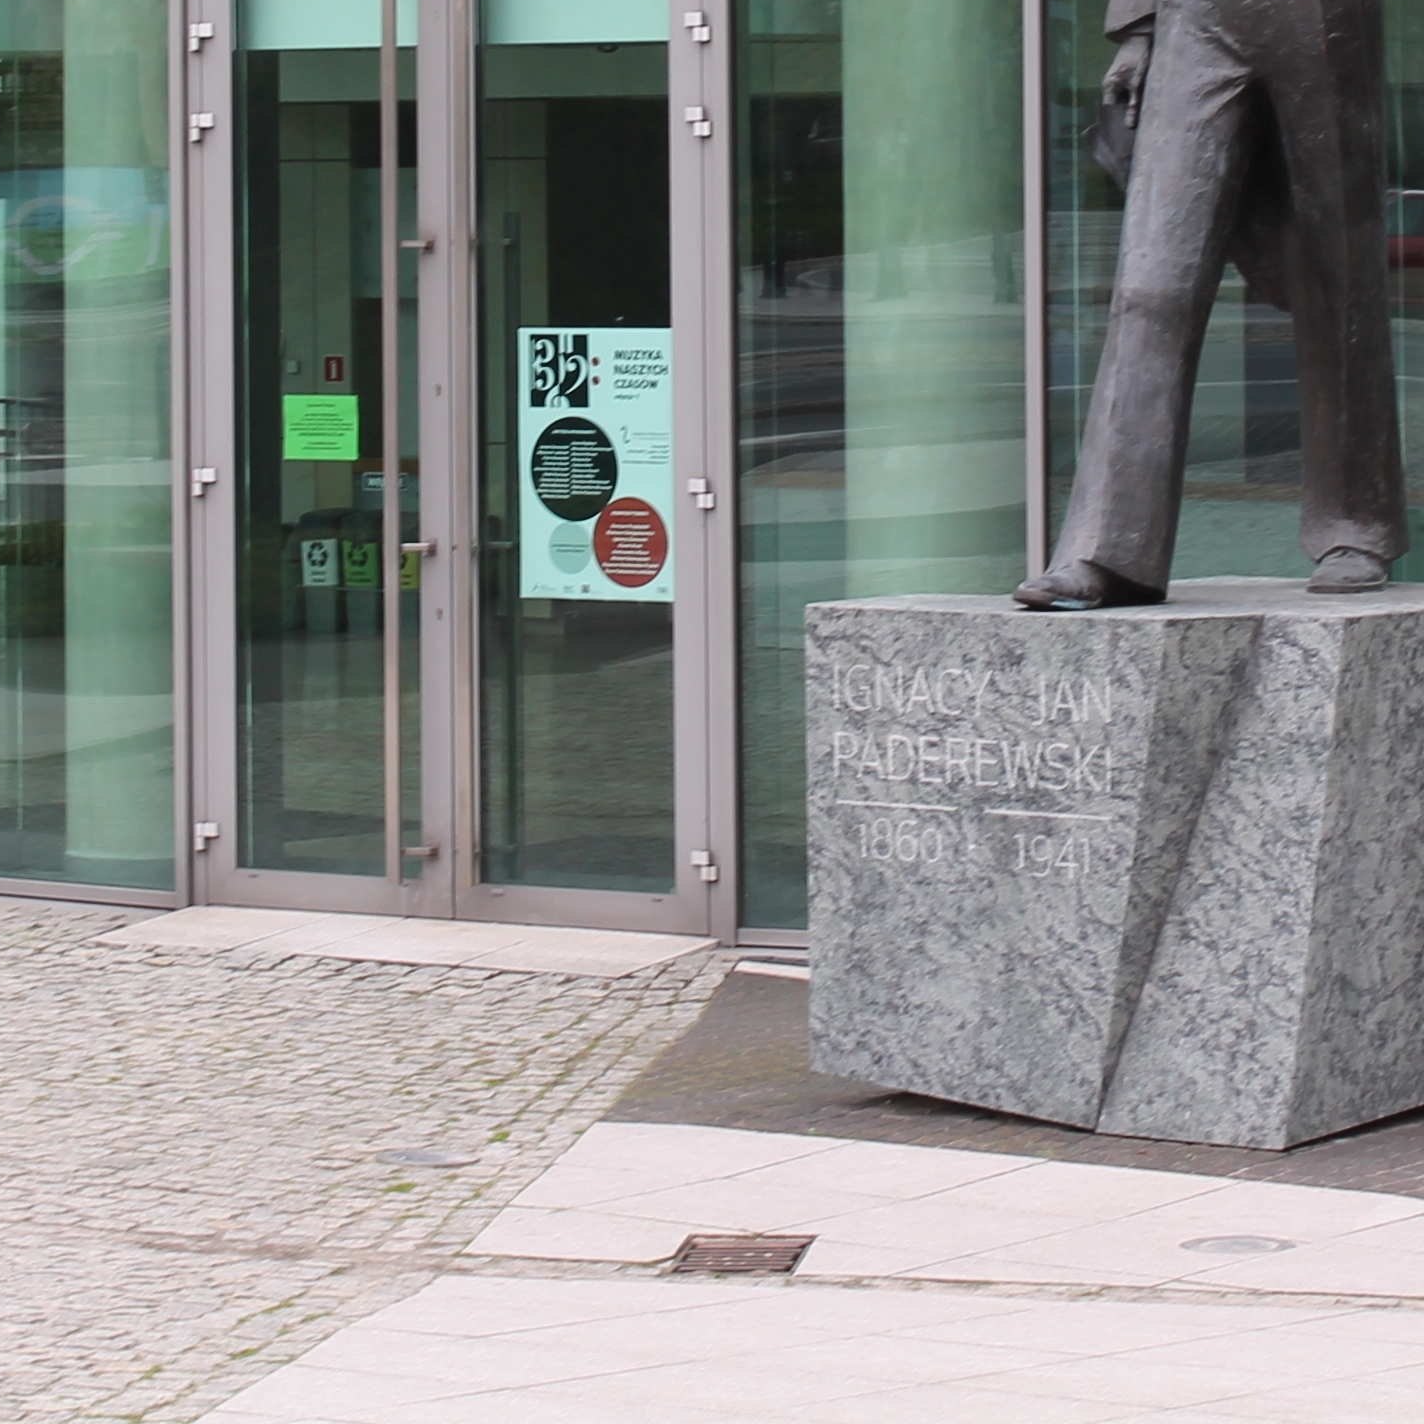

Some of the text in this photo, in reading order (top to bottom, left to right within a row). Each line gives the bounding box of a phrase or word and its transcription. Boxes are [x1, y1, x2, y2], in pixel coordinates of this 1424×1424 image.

[832, 664, 1114, 726] IGNACY JAN
[832, 732, 1115, 794] PADEREWSKI
[855, 817, 1092, 879] 1860 1941
